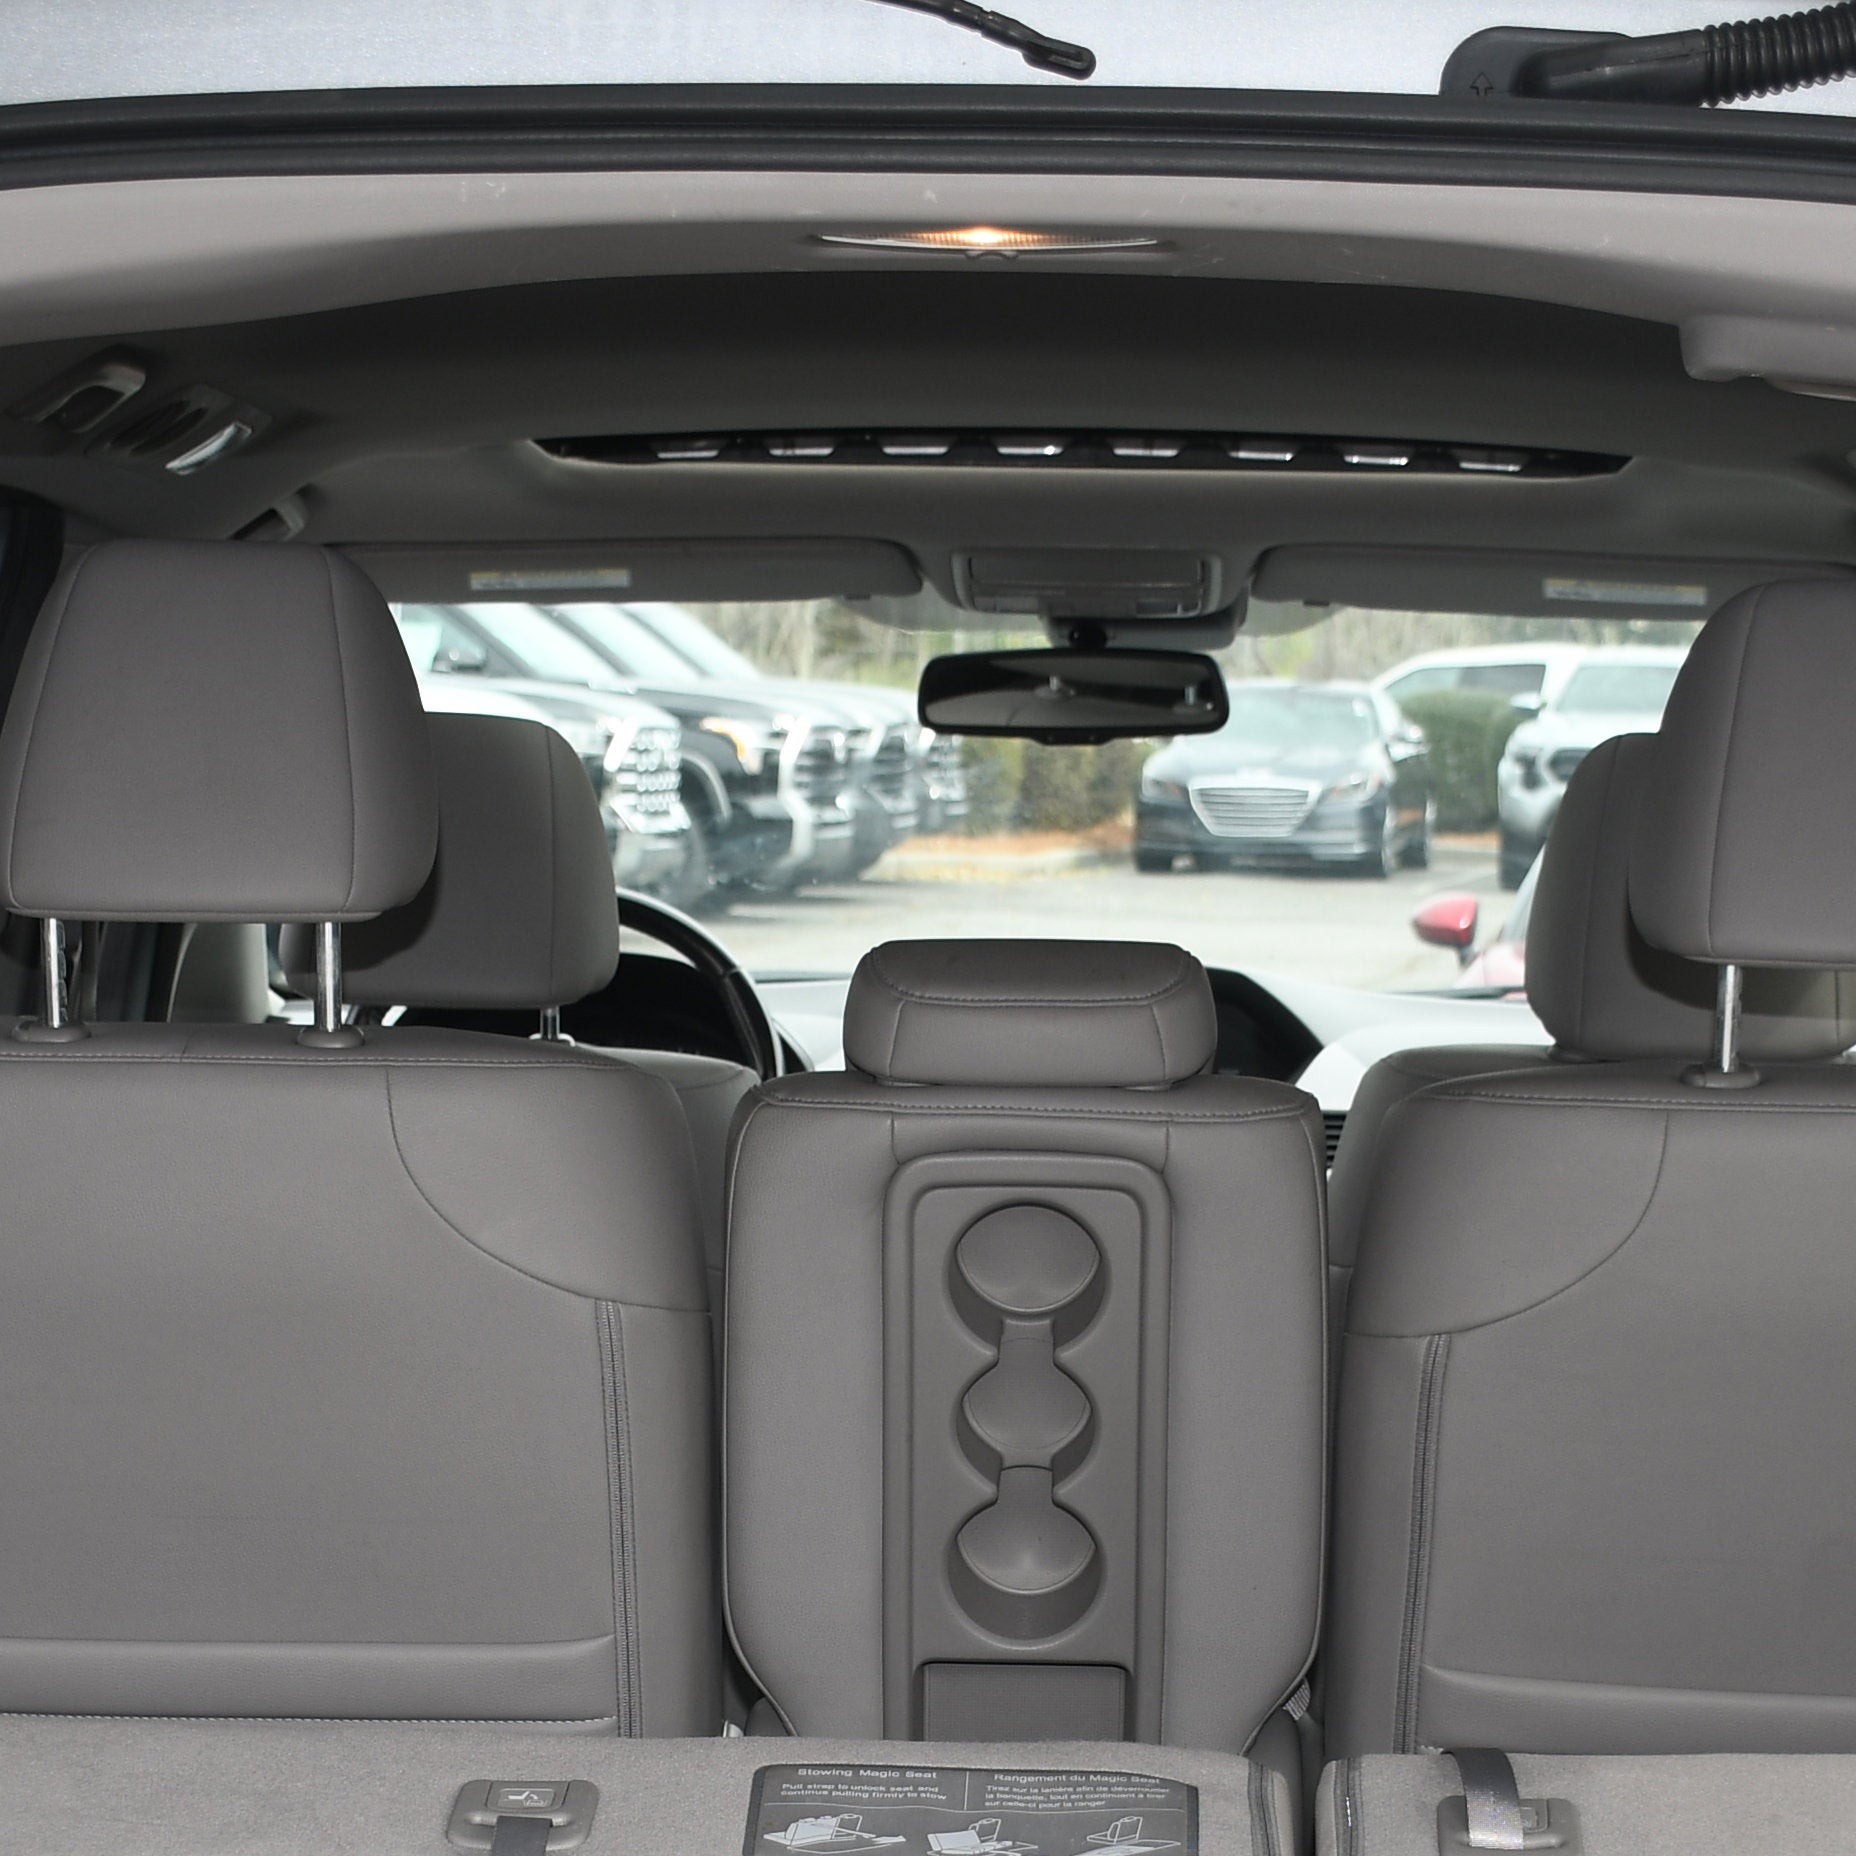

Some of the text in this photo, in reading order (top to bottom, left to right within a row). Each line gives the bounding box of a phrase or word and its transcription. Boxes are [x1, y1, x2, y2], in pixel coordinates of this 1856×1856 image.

[798, 1768, 937, 1779] Stowing Magic Seat
[994, 1773, 1066, 1783] Rangement
[1089, 1774, 1127, 1783] Magic
[1130, 1776, 1159, 1784] Seat
[850, 1784, 886, 1792] unlock
[832, 1790, 869, 1798] pulling
[872, 1791, 906, 1799] firmly
[919, 1792, 947, 1800] stow
